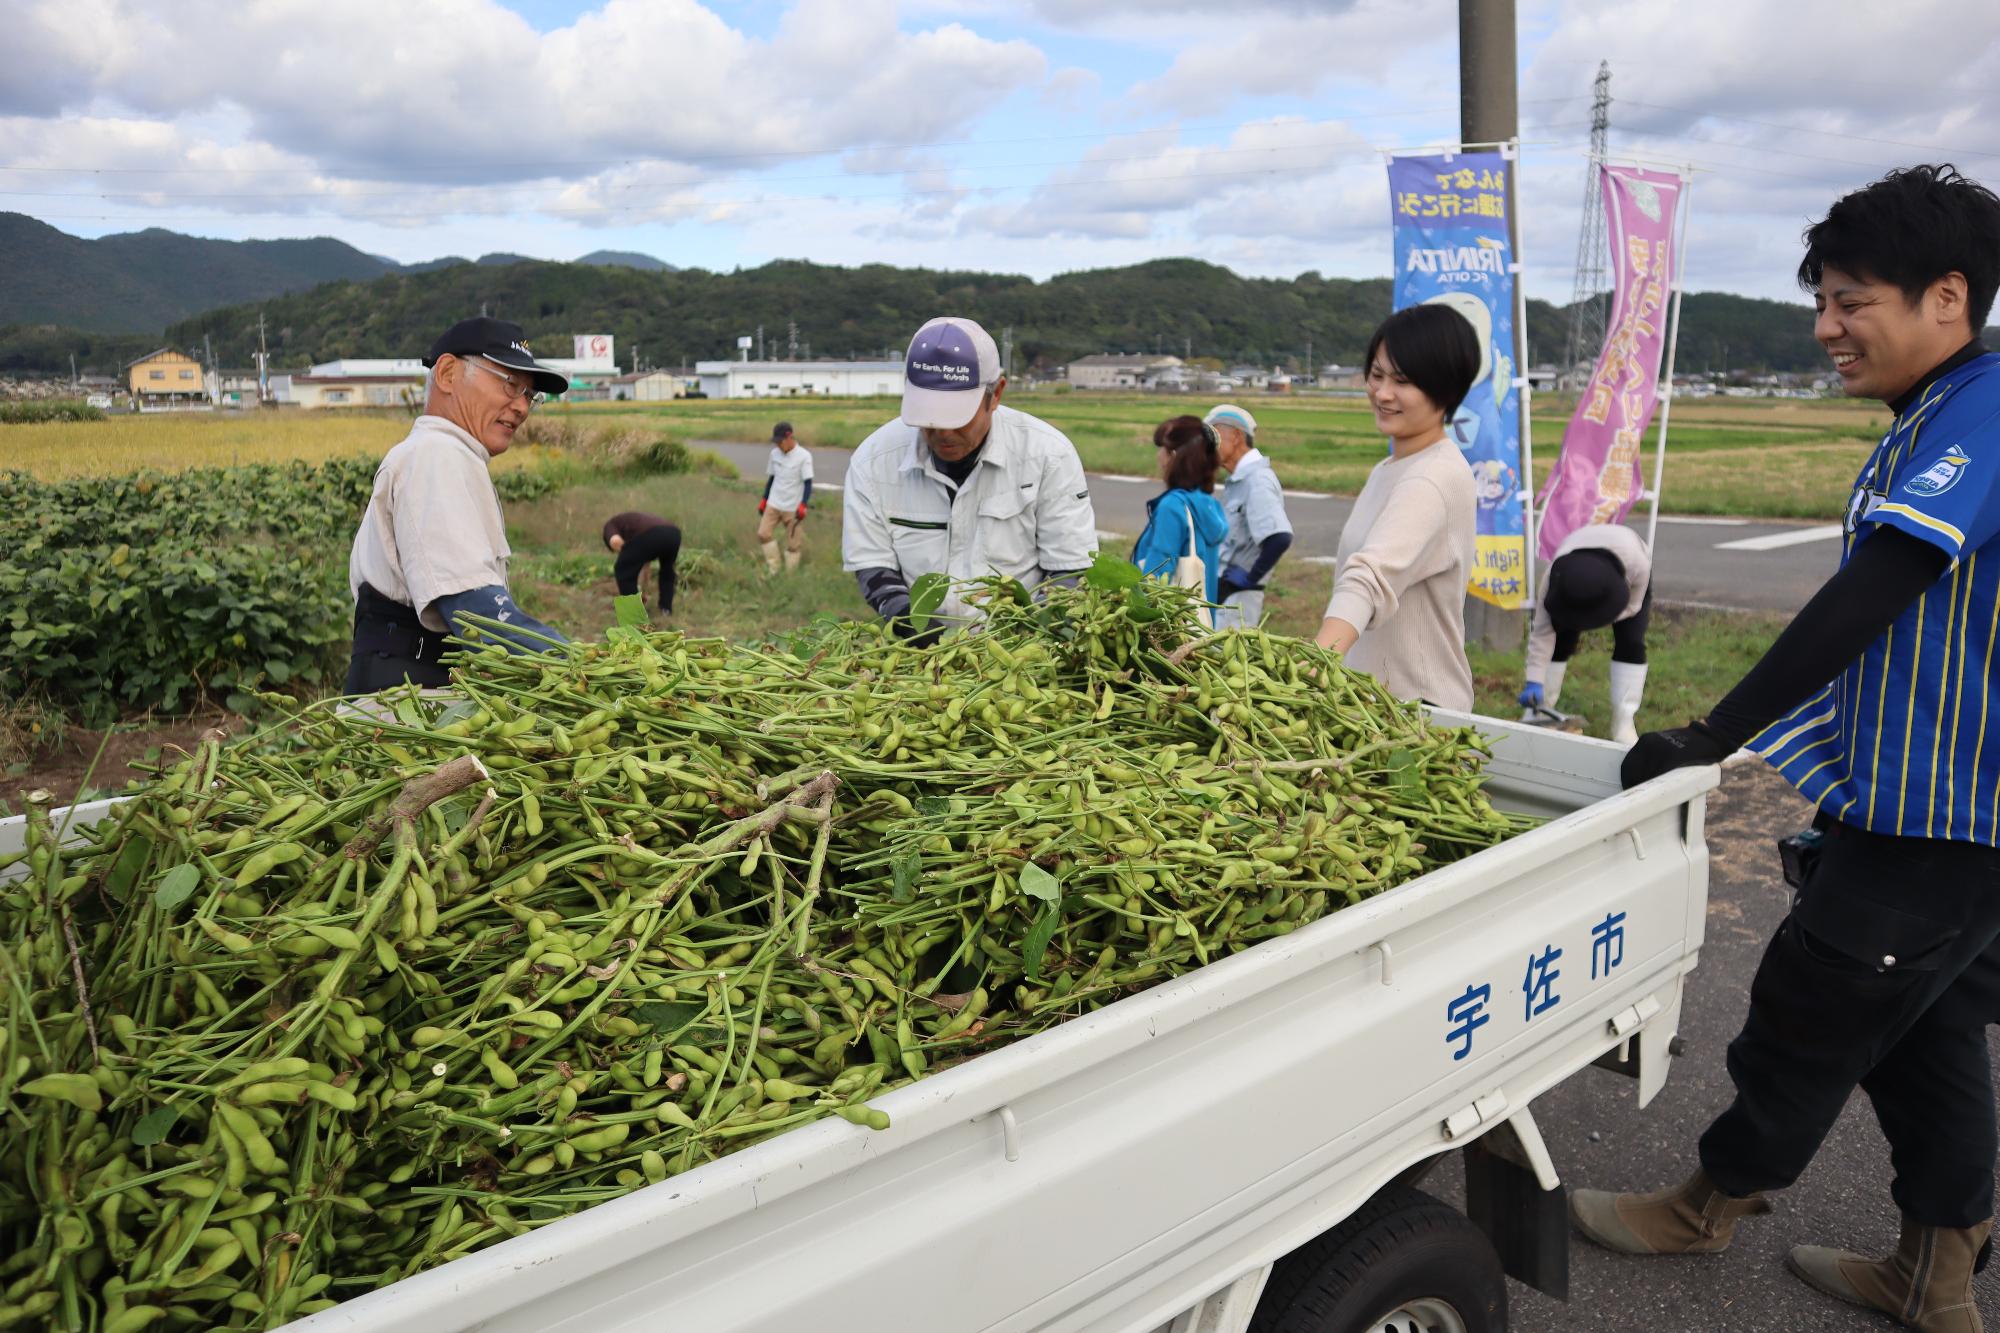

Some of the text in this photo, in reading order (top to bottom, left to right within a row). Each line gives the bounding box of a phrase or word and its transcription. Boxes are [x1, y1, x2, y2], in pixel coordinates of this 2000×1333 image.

[944, 373, 970, 381] Kubota
[1446, 911, 1627, 1061] 宇佐市
